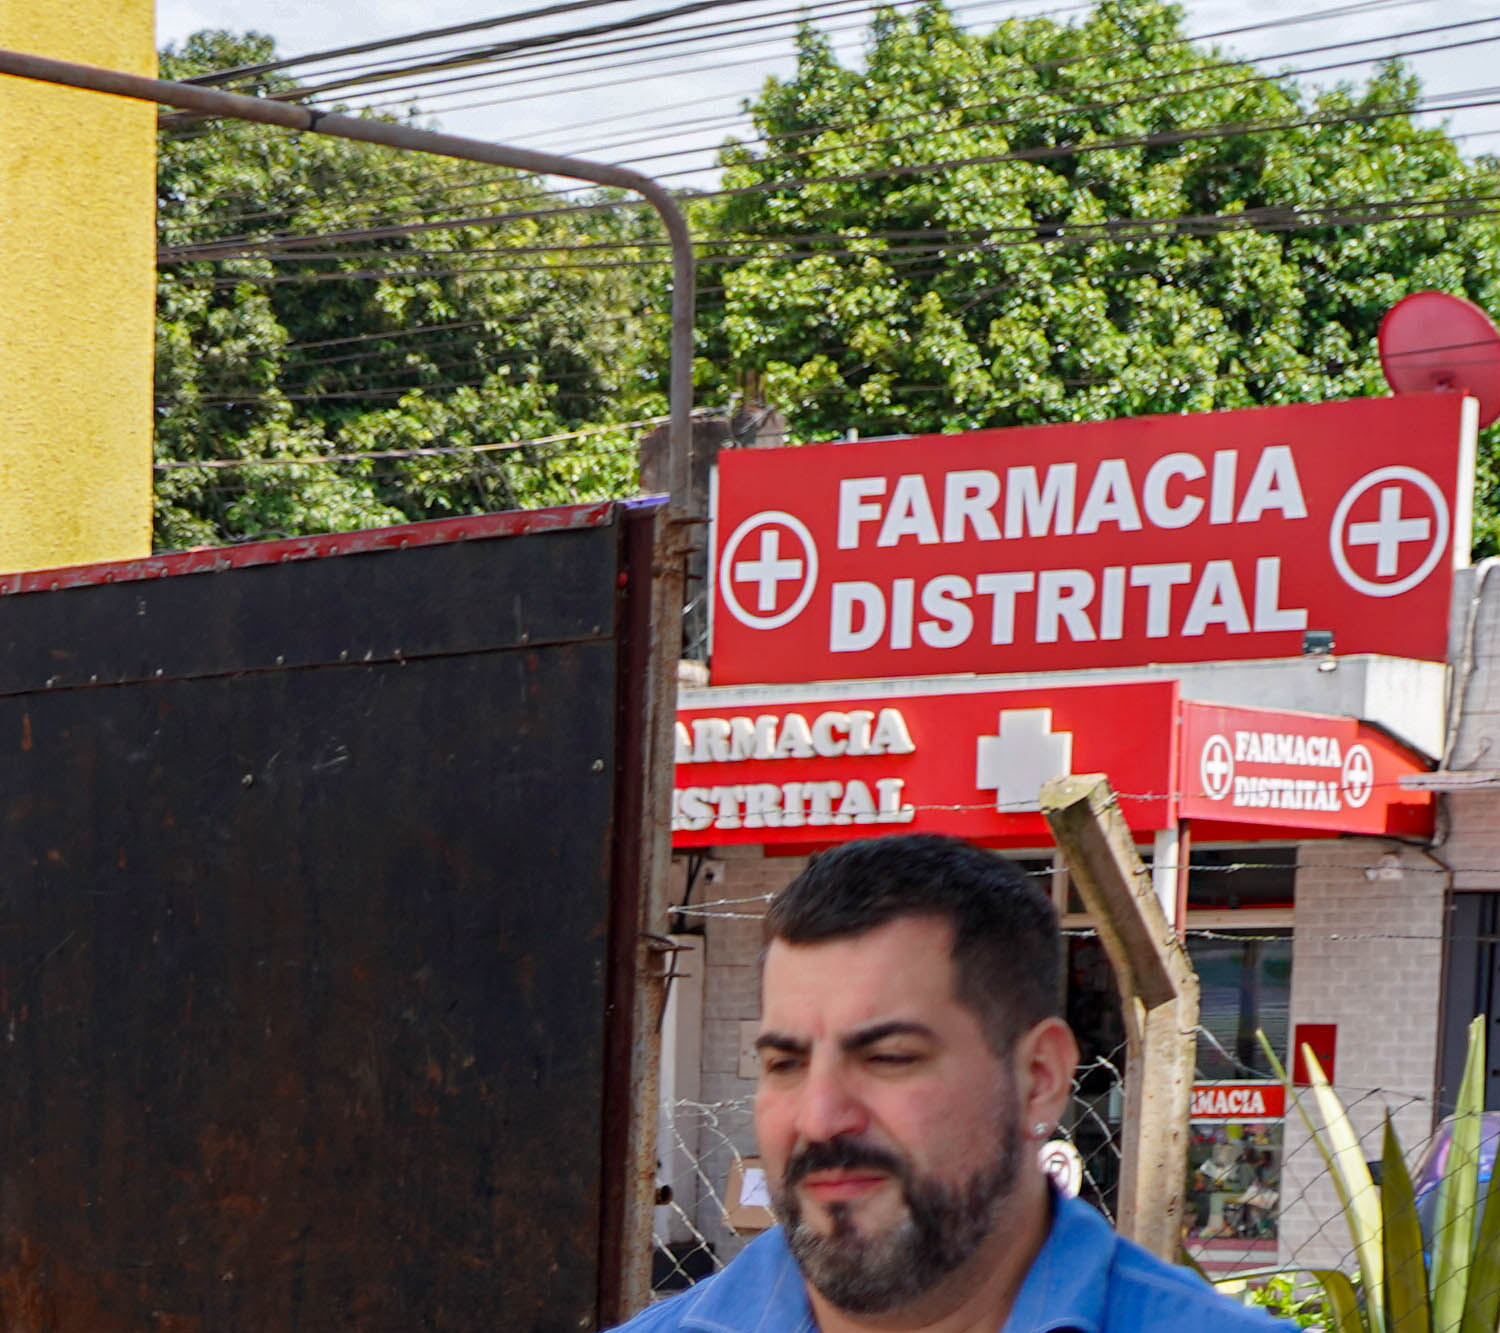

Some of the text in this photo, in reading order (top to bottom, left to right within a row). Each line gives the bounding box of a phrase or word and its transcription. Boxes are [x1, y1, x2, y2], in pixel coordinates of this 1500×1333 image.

[836, 445, 1308, 549] FARMACIA
[829, 557, 1308, 653] DISTRITAL
[1234, 731, 1343, 768] FARMACIA
[1232, 776, 1343, 812] DISTRITAL
